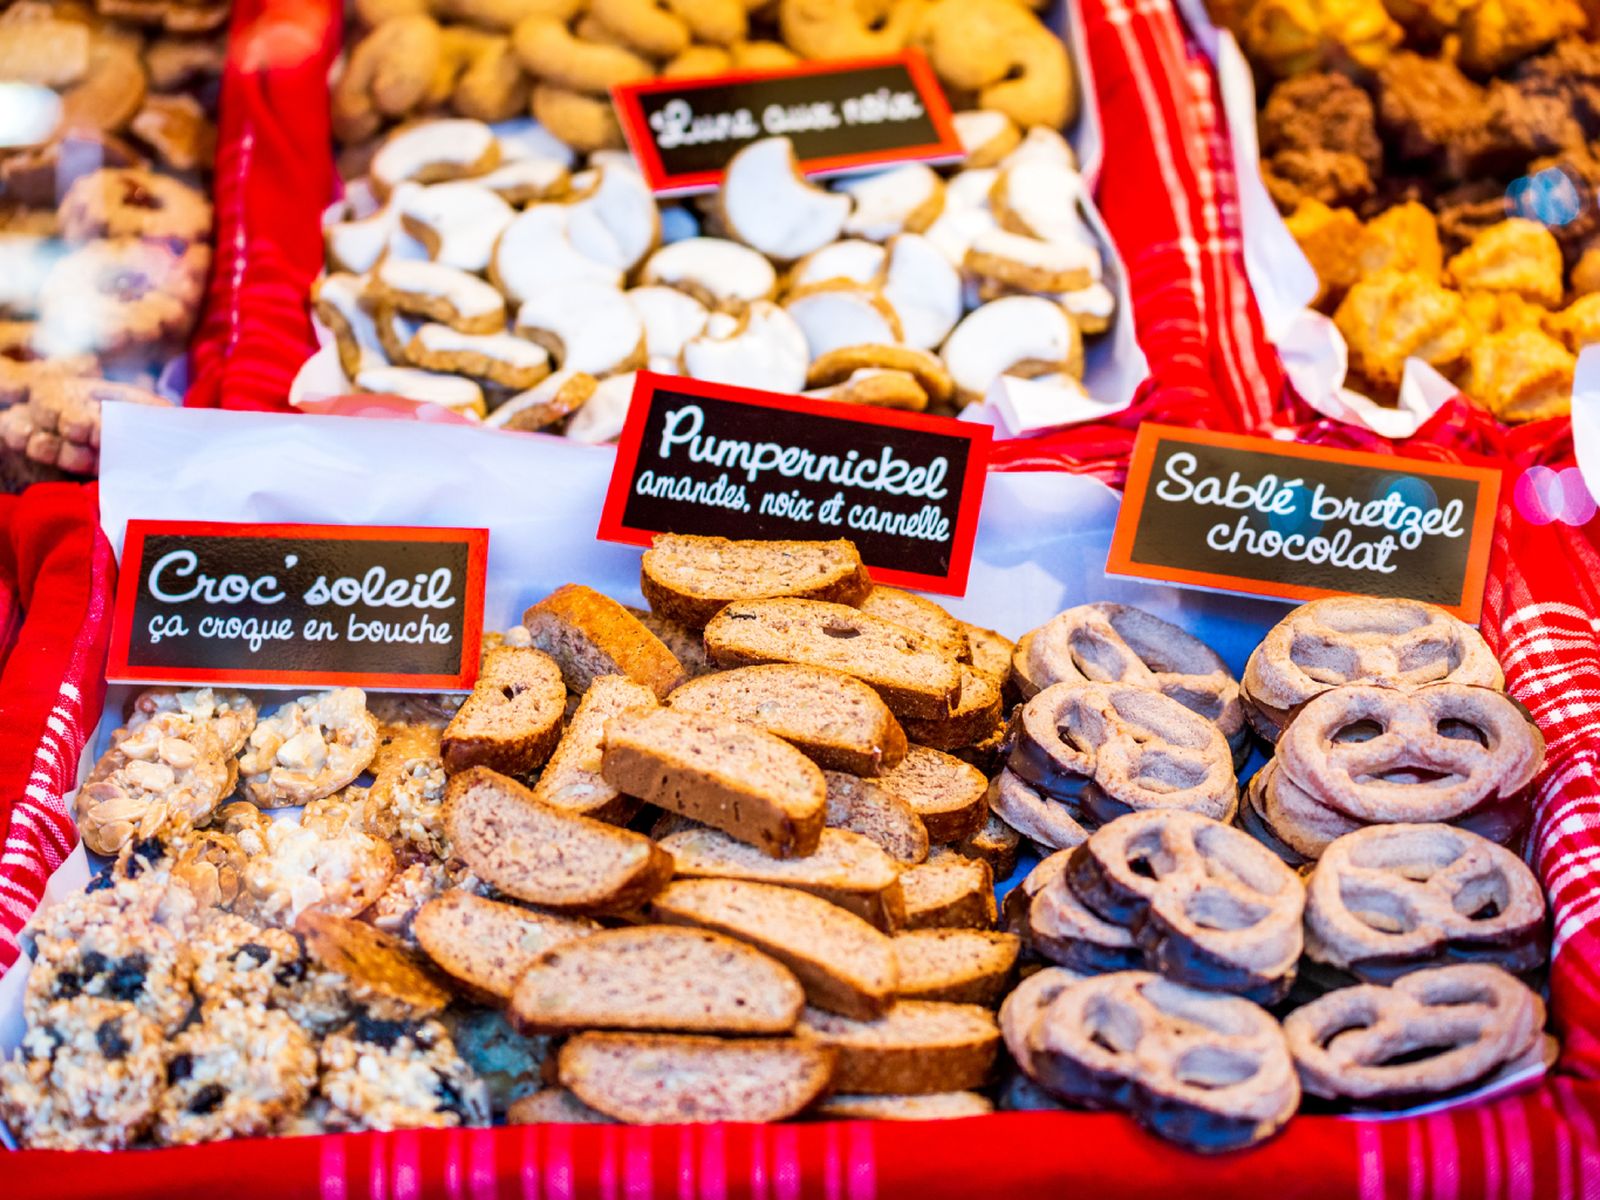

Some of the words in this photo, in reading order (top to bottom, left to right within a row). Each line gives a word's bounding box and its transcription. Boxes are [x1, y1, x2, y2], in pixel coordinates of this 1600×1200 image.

[658, 404, 949, 500] Pumpernickel
[636, 469, 751, 514] amandes,
[758, 490, 814, 522] noix
[817, 492, 846, 525] et
[847, 504, 951, 543] cannelle
[1155, 451, 1305, 516] Sablé
[1309, 482, 1466, 551] bretzel
[1206, 515, 1400, 574] chocolat
[148, 549, 299, 604] Croc'
[303, 565, 457, 609] soleil
[148, 613, 190, 644] ça
[198, 614, 295, 653] croque
[303, 617, 339, 642] en
[346, 613, 453, 645] bouche
